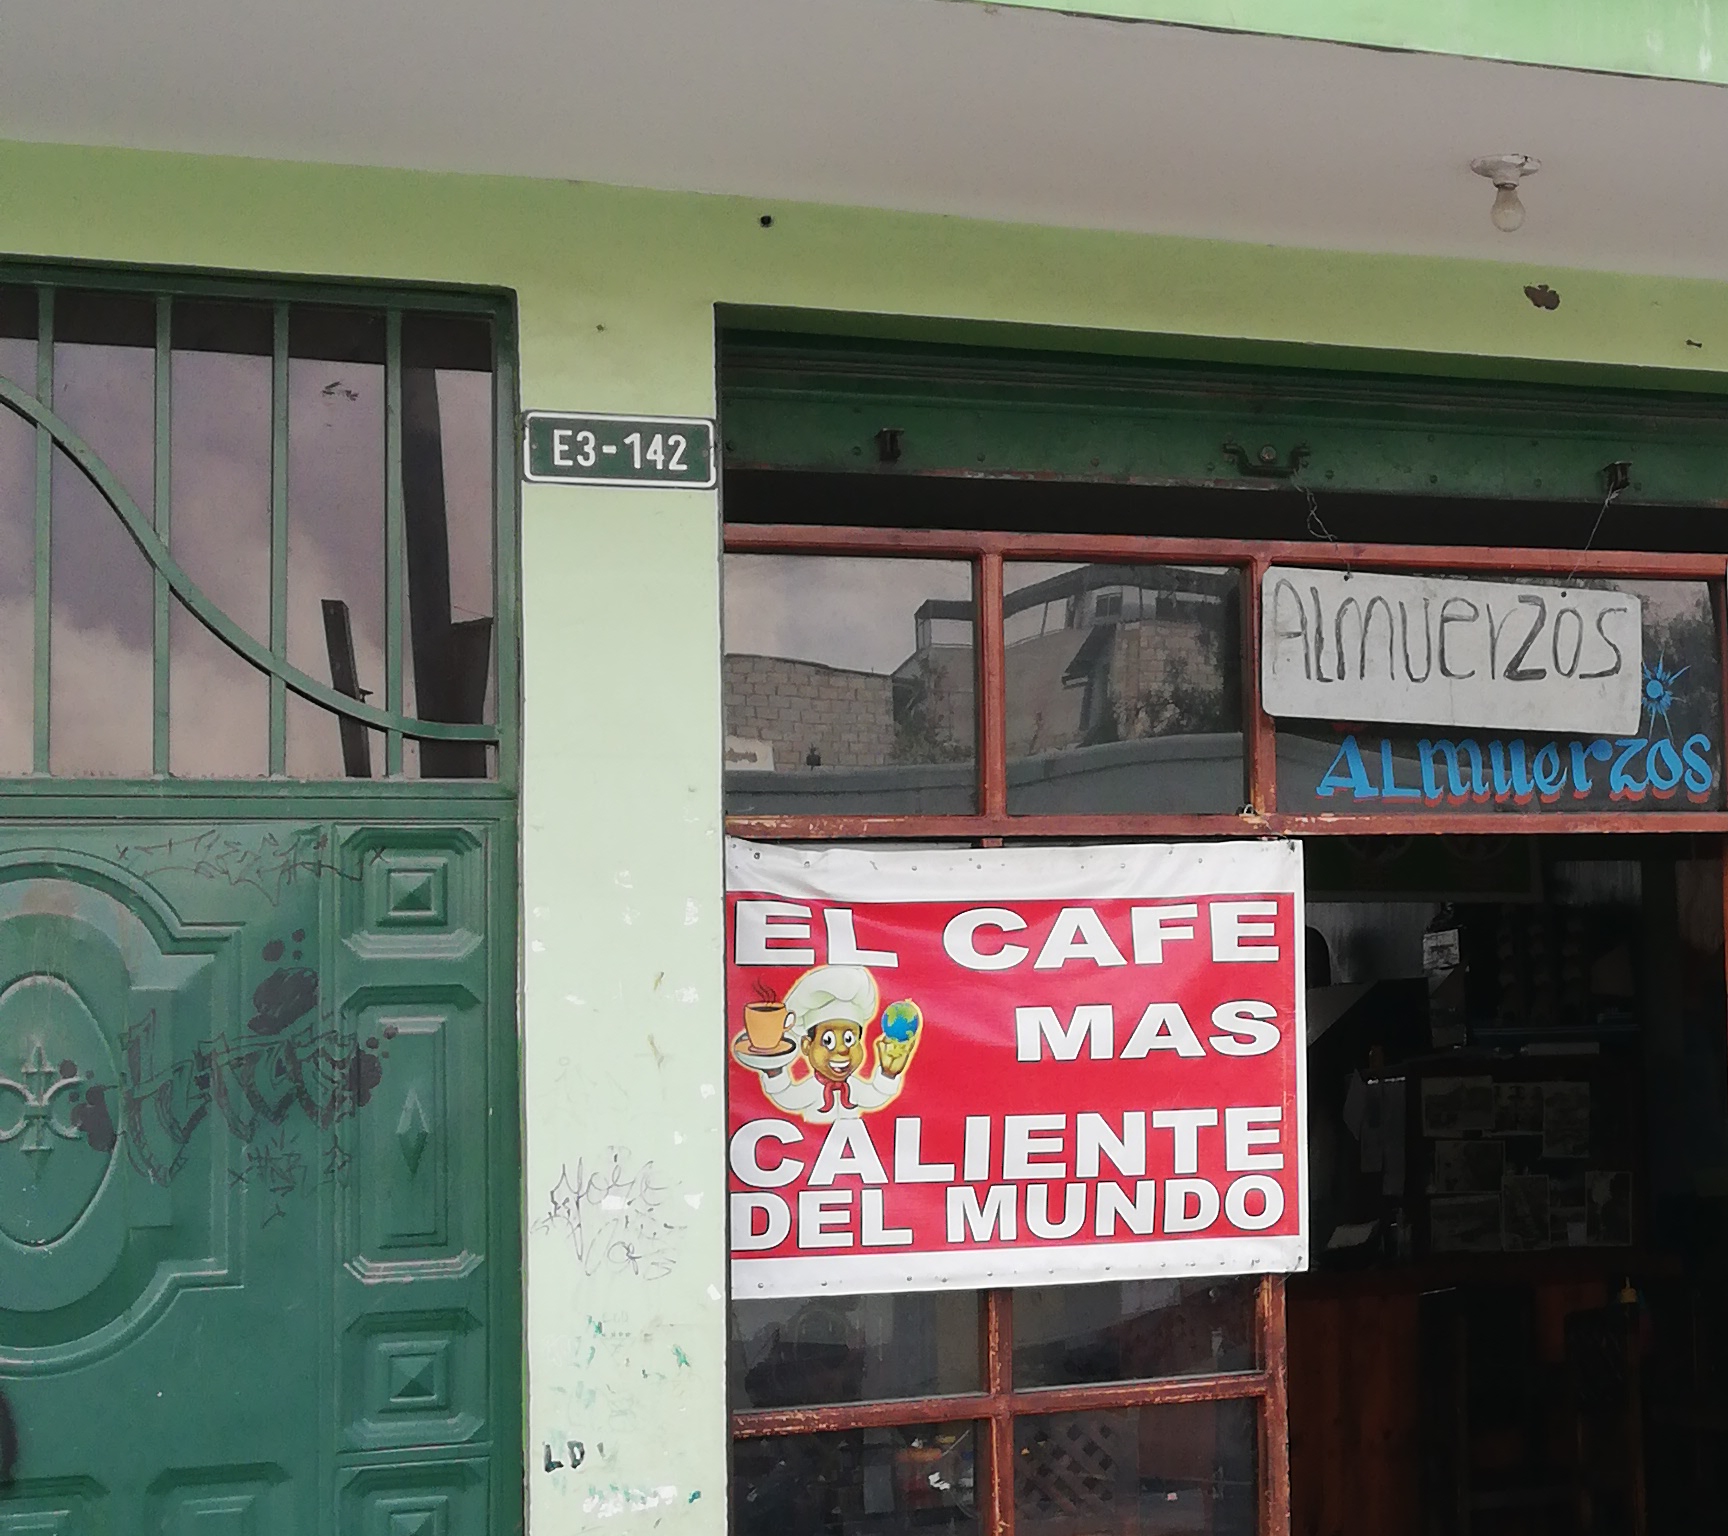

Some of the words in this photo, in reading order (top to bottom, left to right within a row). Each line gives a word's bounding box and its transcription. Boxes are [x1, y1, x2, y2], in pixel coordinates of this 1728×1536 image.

[553, 428, 689, 472] E3-142
[735, 900, 899, 968] EL
[942, 901, 1281, 970] CAFE
[1015, 1000, 1282, 1062] MAS
[729, 1106, 1285, 1189] CALIENTE
[730, 1188, 914, 1251] DEL
[946, 1174, 1285, 1245] MUNDO
